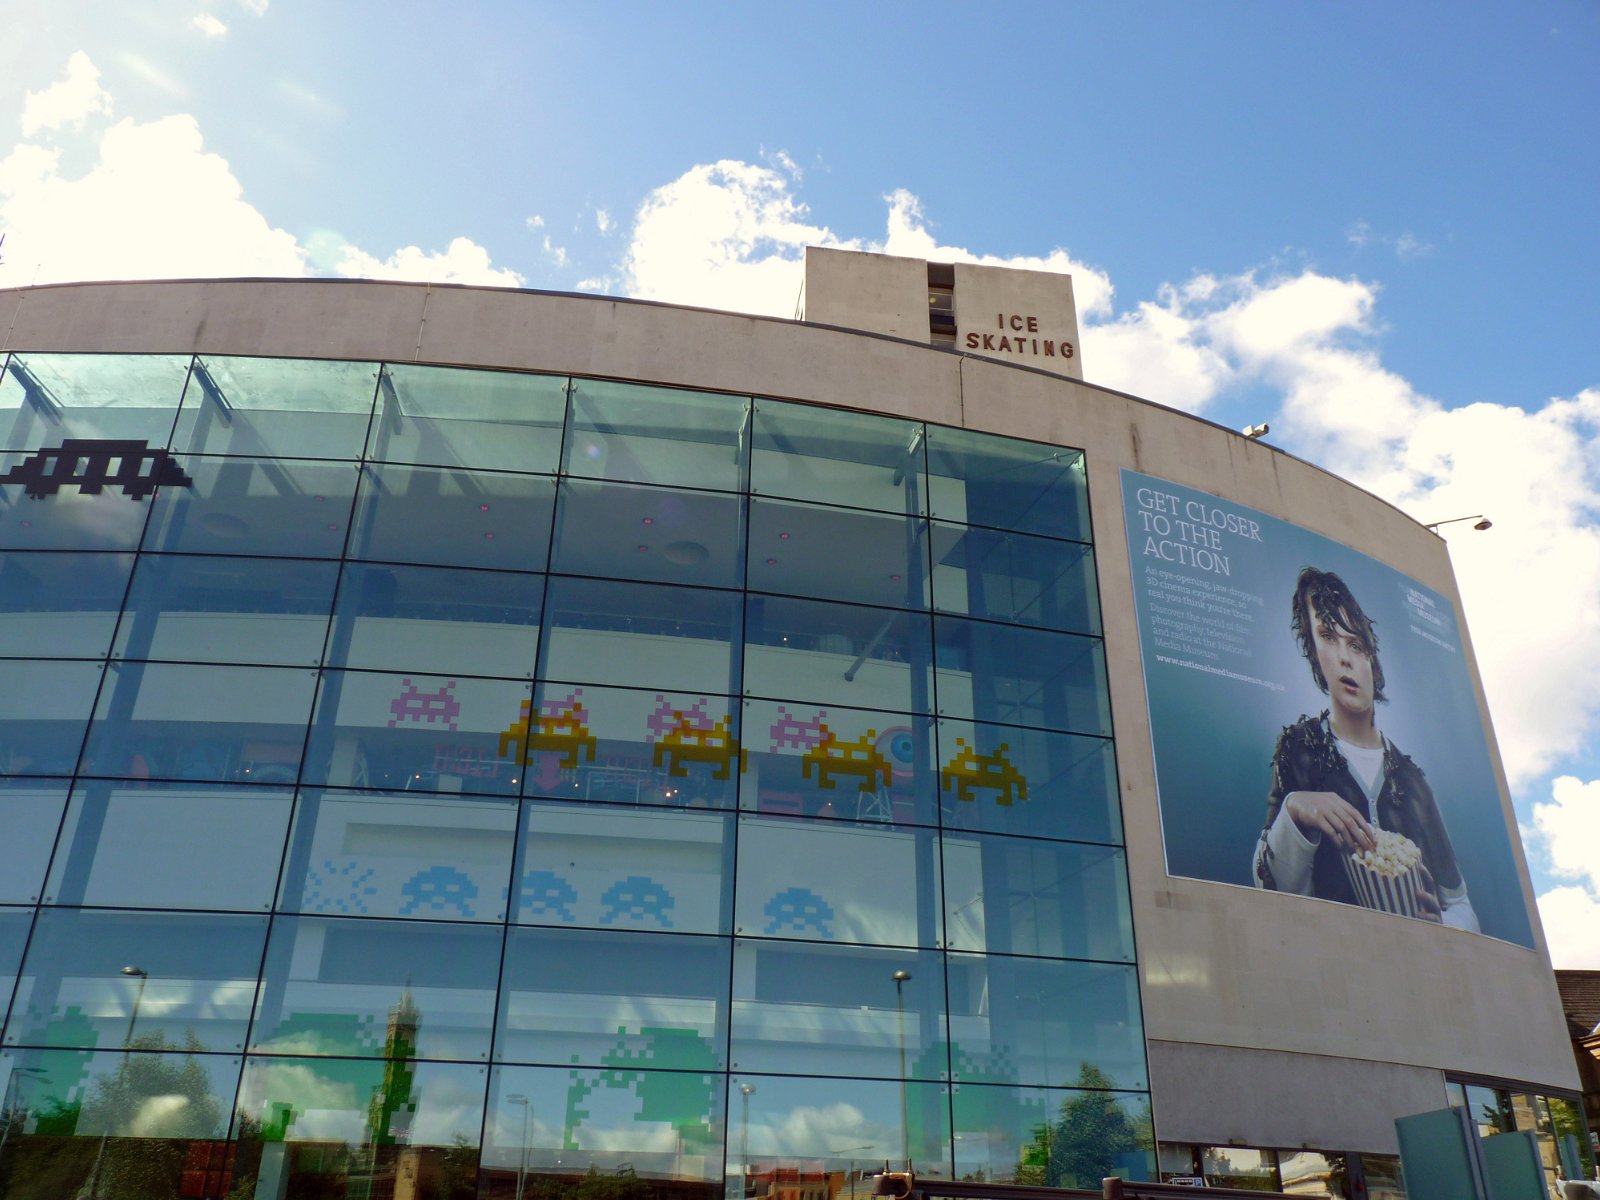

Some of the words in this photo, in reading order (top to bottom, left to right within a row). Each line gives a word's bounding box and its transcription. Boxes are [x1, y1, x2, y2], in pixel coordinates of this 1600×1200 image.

[998, 313, 1038, 333] ICE
[966, 332, 1074, 359] SKATING
[1137, 488, 1180, 516] GET
[1186, 501, 1263, 542] CLOSER
[1138, 510, 1170, 536] TO
[1175, 520, 1222, 551] THE
[1143, 536, 1230, 576] ACTION
[1145, 565, 1158, 575] An
[1146, 577, 1158, 586] 3D
